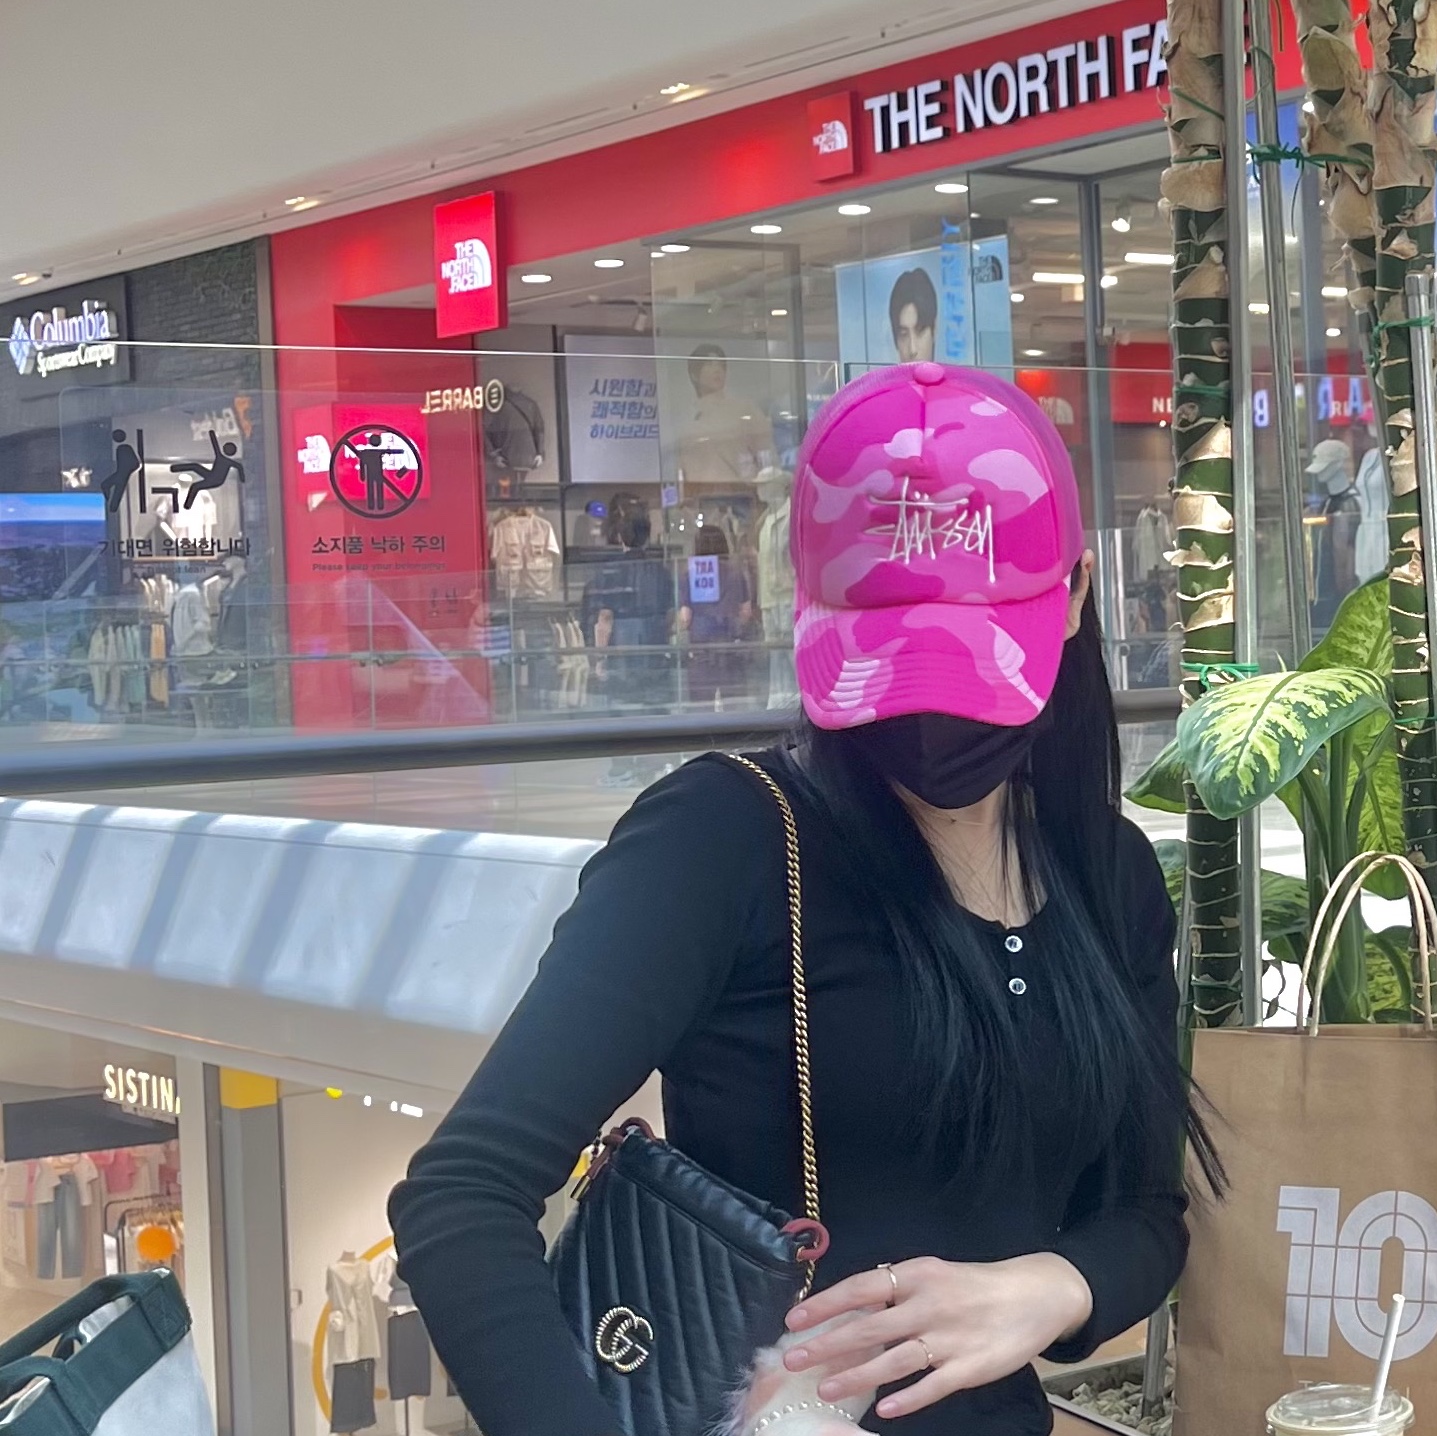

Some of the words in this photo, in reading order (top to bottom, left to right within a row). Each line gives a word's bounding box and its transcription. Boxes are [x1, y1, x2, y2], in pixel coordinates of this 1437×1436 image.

[863, 80, 946, 154] THE
[953, 35, 1109, 134] NORTH
[1121, 19, 1169, 92] FA
[29, 299, 110, 350] Columbia
[589, 378, 657, 398] 시원함과
[591, 401, 659, 420] 쾌적함의
[590, 423, 660, 439] 하이브리드
[162, 537, 250, 557] 위험합니다
[312, 536, 363, 554] 소지품
[371, 536, 405, 553] 낙하
[411, 535, 446, 553] 주의
[312, 563, 342, 571] Please
